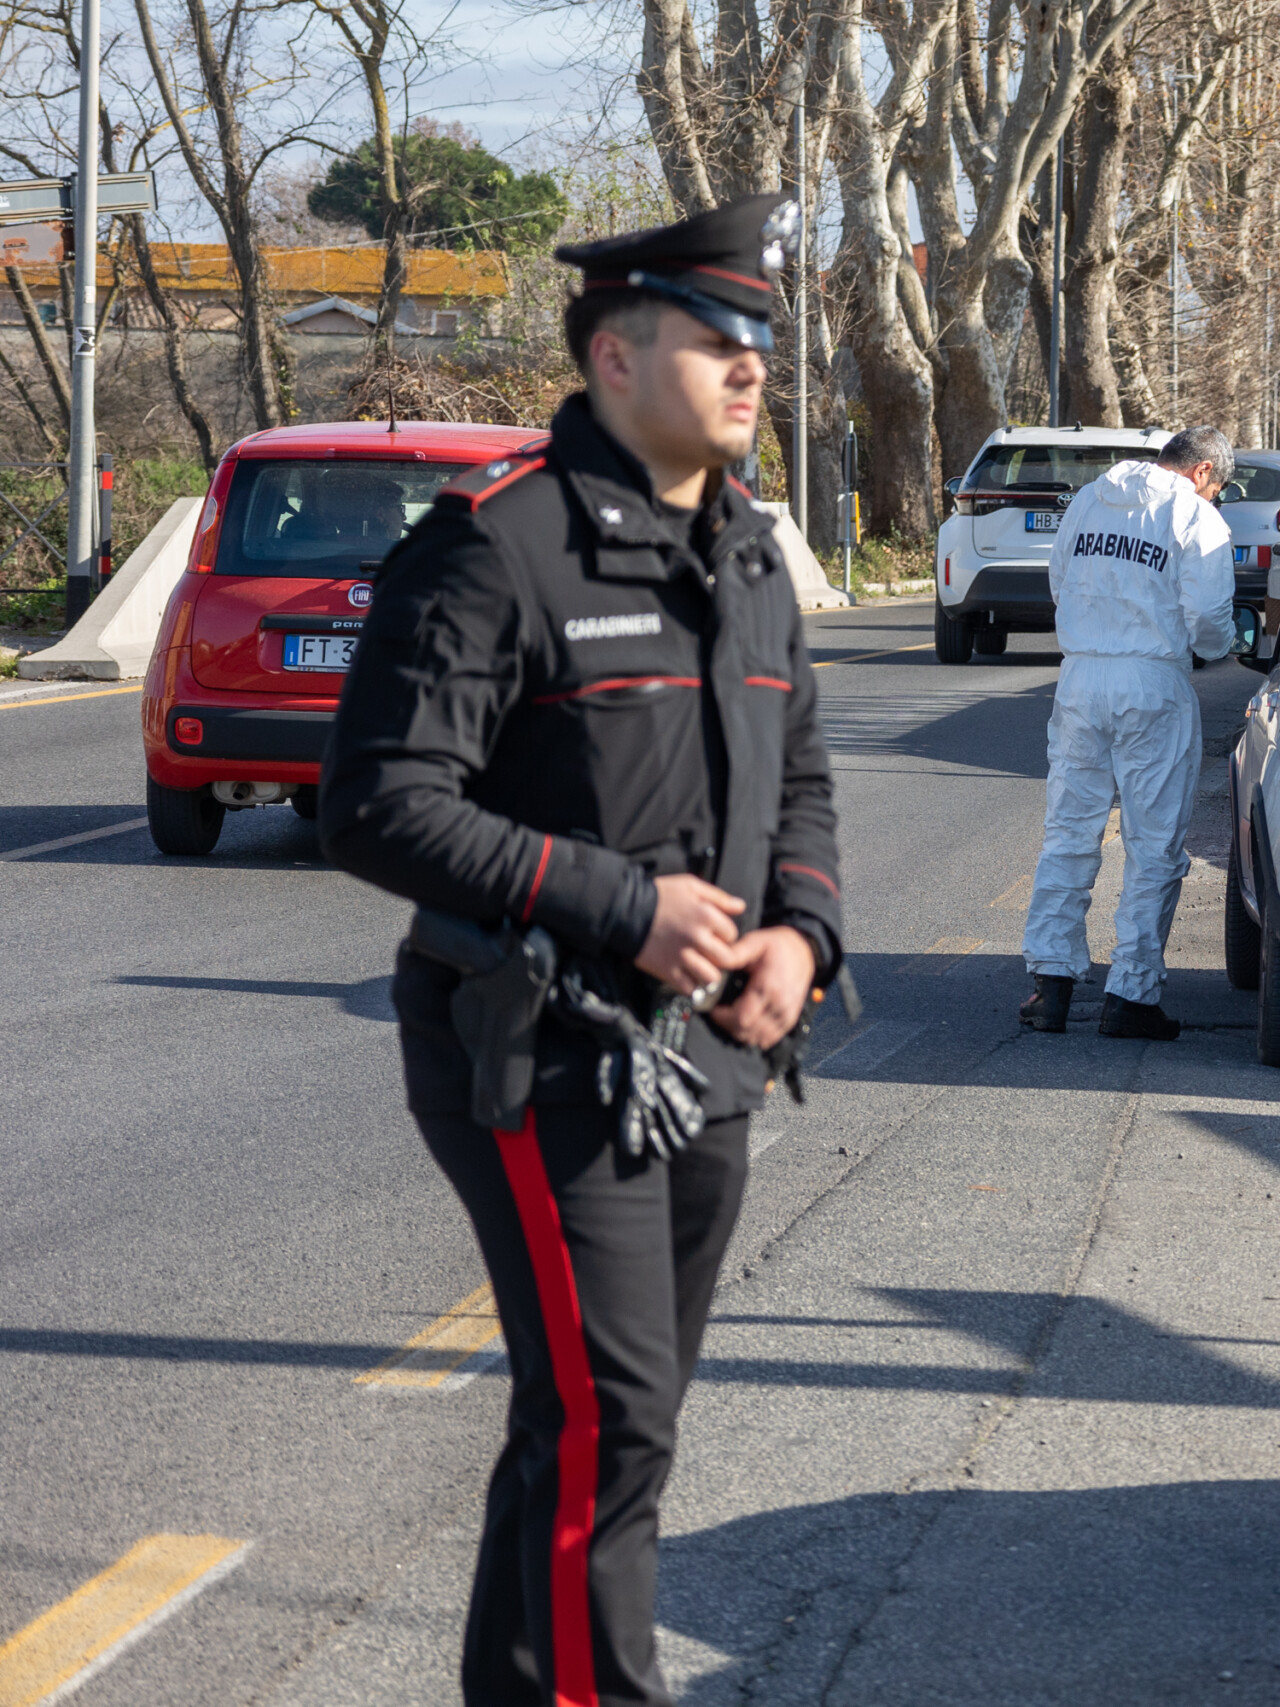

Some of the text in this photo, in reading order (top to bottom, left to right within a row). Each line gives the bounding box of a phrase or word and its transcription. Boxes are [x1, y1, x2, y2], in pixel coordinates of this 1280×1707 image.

[354, 589, 370, 601] FIAT
[564, 612, 662, 641] CARABINIERI
[302, 638, 331, 663] FT
